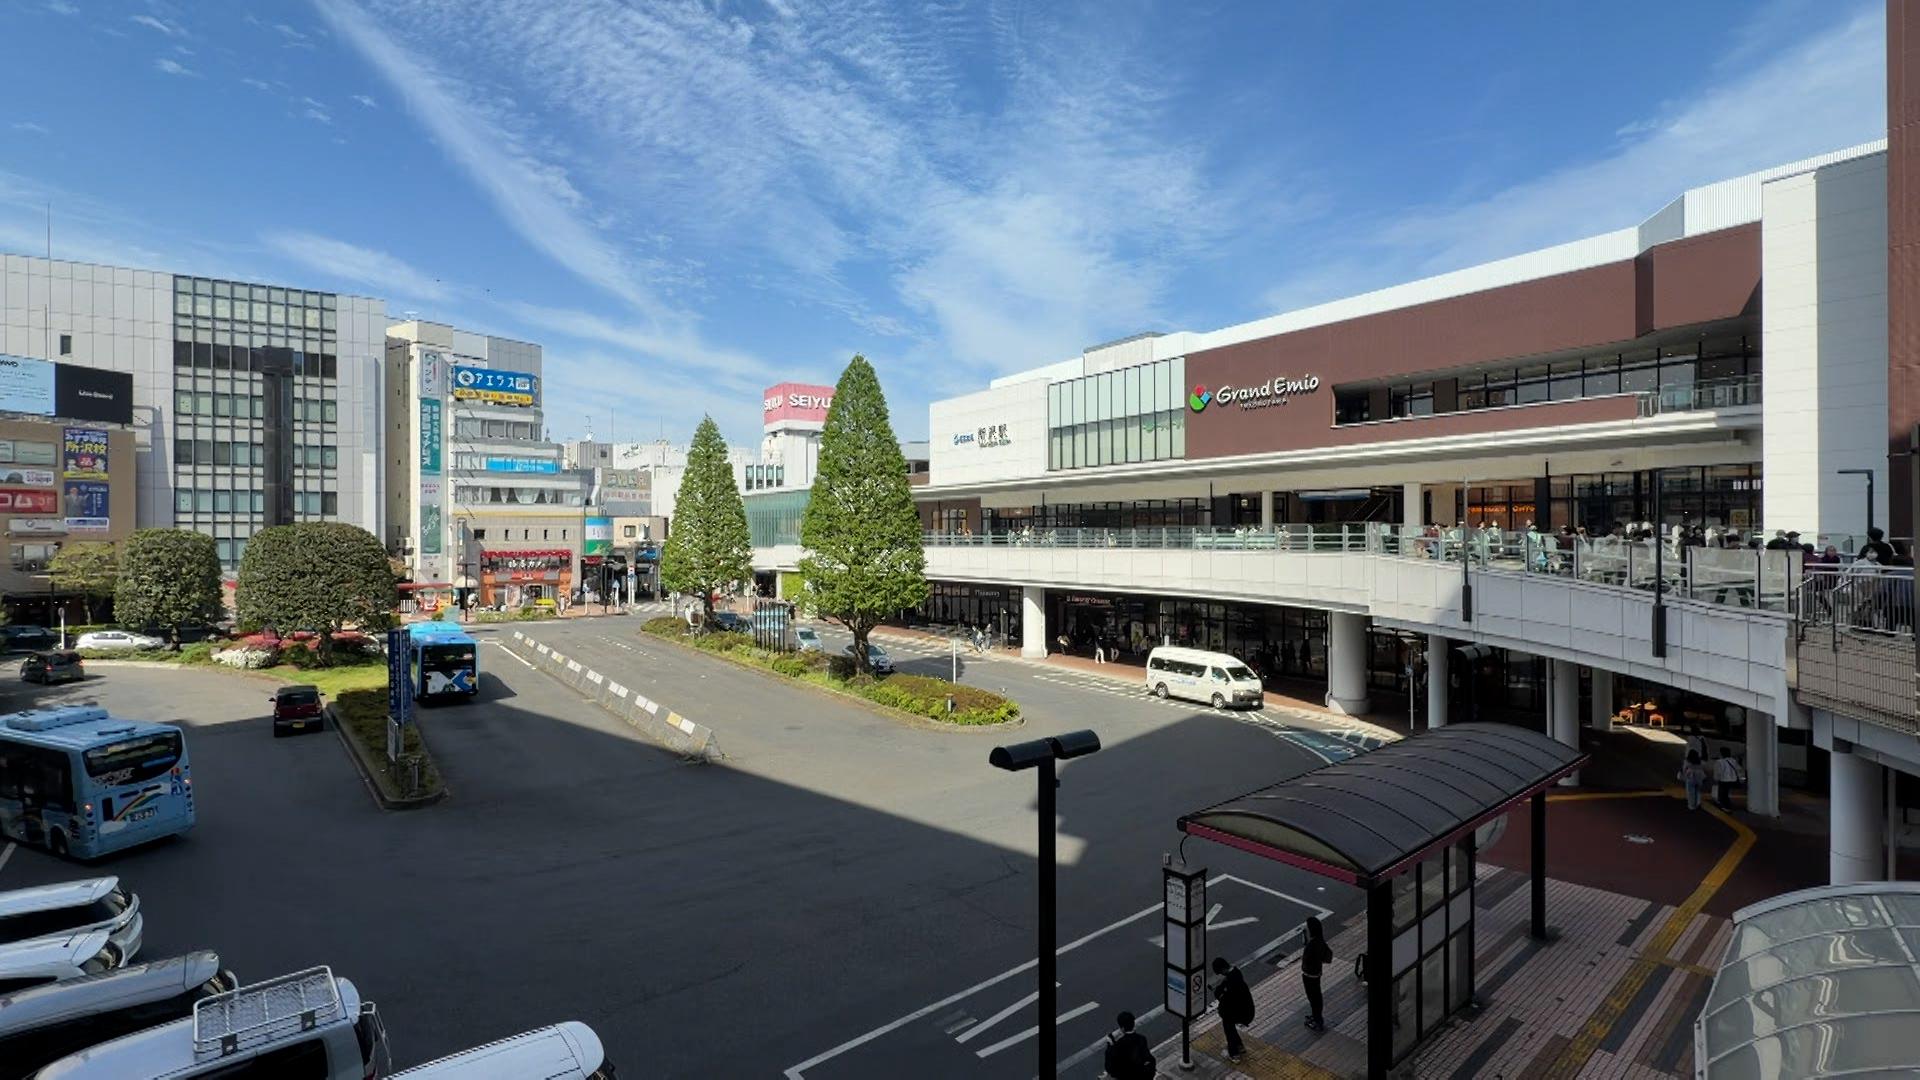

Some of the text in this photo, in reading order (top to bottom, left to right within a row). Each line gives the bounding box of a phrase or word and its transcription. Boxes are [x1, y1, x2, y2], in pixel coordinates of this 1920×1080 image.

[1216, 373, 1320, 404] Grand Emio
[788, 393, 833, 409] SEIYU
